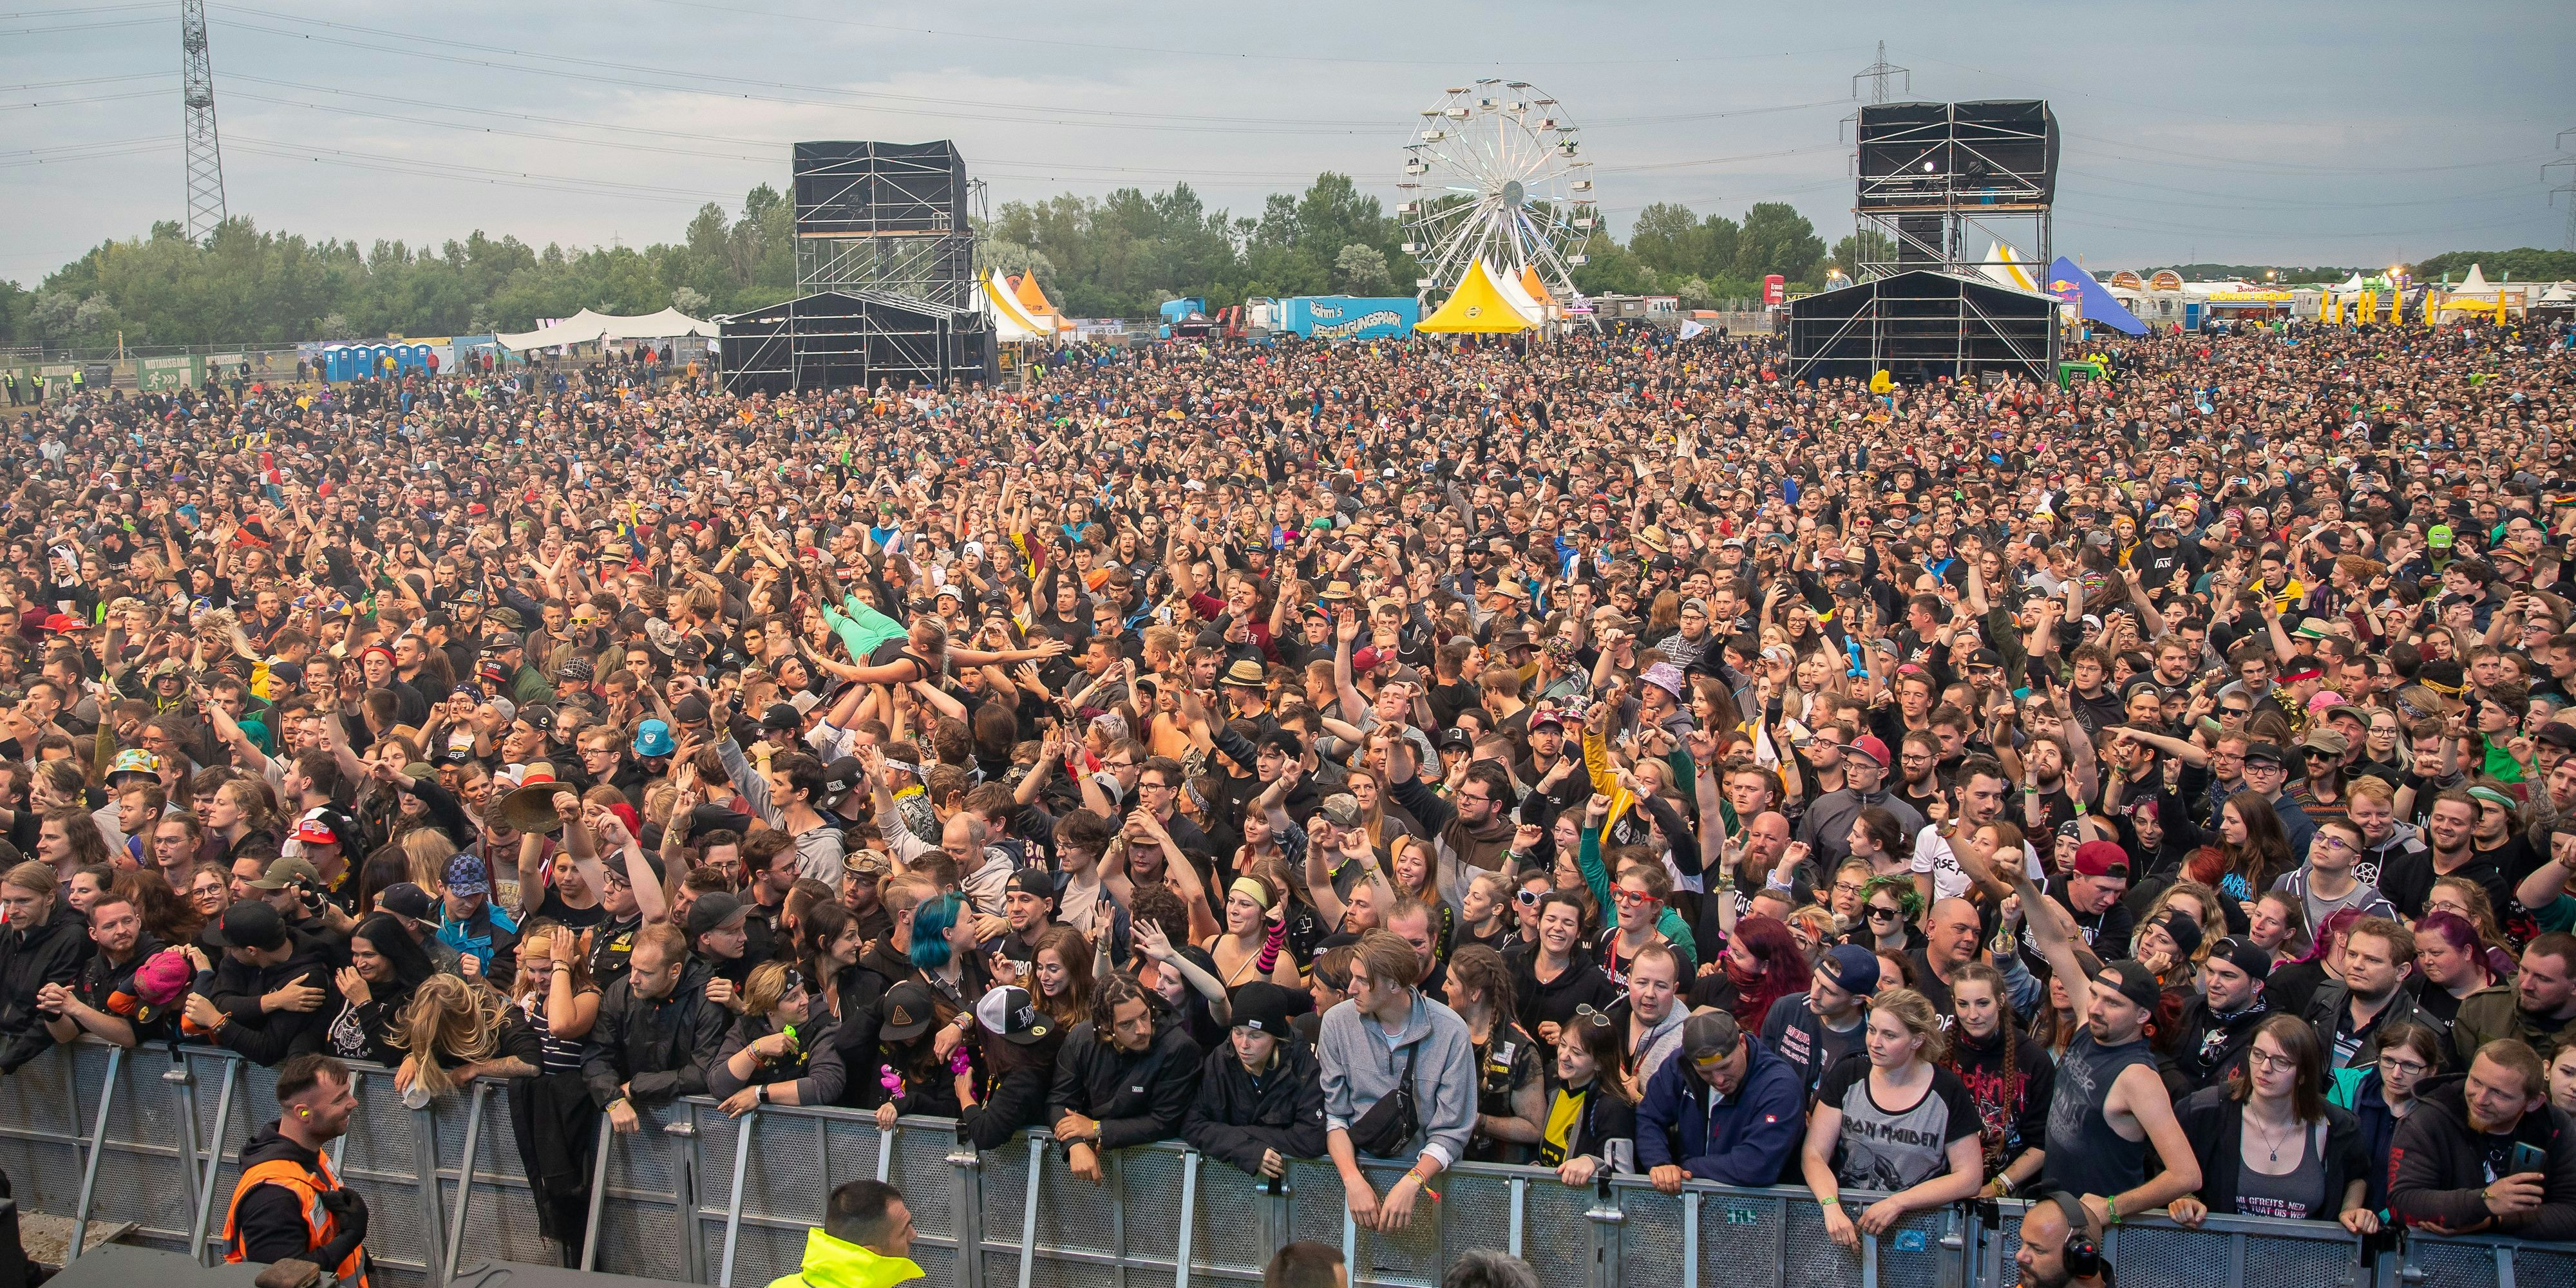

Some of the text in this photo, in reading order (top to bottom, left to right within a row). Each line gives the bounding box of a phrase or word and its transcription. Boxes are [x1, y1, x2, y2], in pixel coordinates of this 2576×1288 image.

[2209, 291, 2293, 301] DÖNER KEBAP
[1311, 310, 1402, 337] VERGNÜGUNGSPARK
[145, 357, 191, 370] NOTAUSGANG
[206, 354, 243, 366] NOTAUSGANG
[41, 365, 75, 377] NOTAUSGANG
[1274, 536, 1284, 546] HOT
[1933, 857, 1955, 873] RISE
[333, 1041, 373, 1058] Voodoo
[1880, 1124, 1940, 1151] MAIDEN
[2249, 1197, 2284, 1208] GFREITS
[2287, 1202, 2306, 1211] NED
[2251, 1205, 2271, 1215] TUAT
[2274, 1209, 2287, 1218] OIS
[2289, 1211, 2307, 1219] WEH
